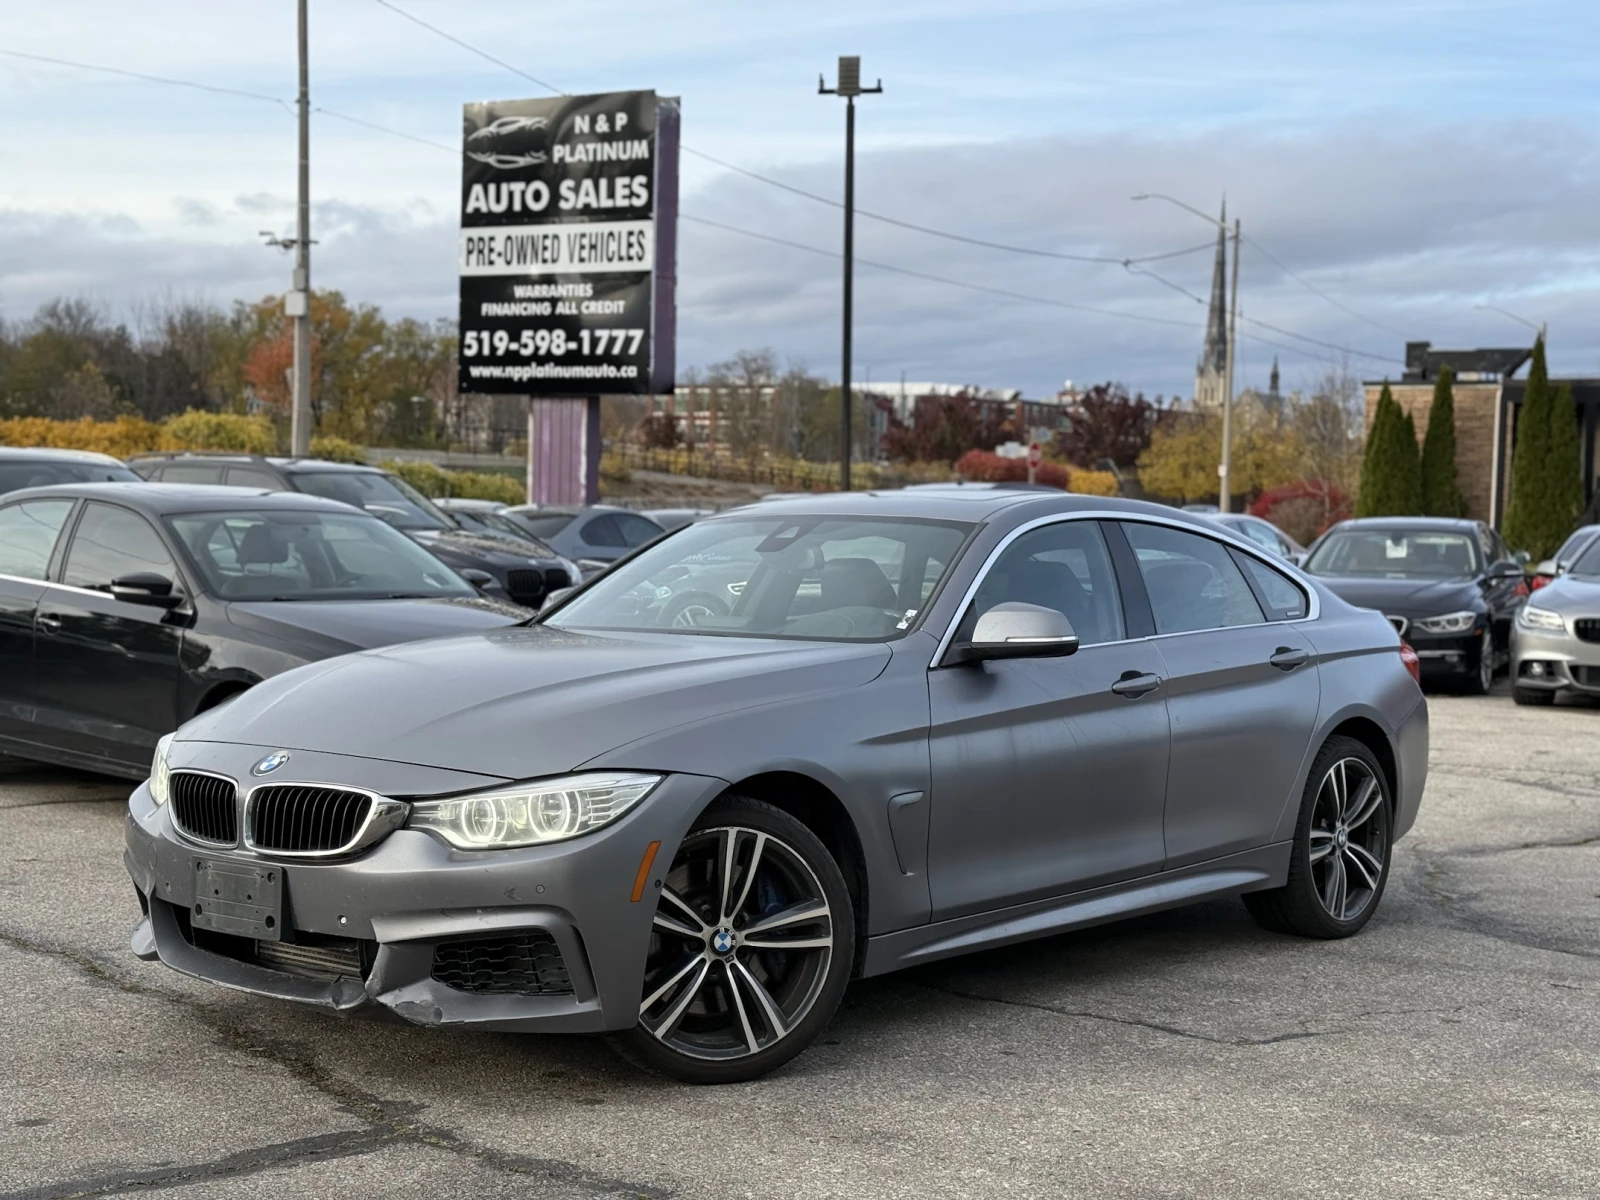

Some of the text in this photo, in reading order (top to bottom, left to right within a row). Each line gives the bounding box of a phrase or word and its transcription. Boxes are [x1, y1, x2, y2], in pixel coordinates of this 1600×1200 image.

[574, 111, 628, 134] N & P
[552, 139, 649, 164] PLATINUM
[465, 175, 649, 213] AUTO SALES
[466, 230, 646, 267] PRE-OWNED VEHICLES
[513, 283, 594, 299] WARRANTIES
[481, 300, 626, 317] FINANCING ALL CREDIT
[463, 328, 645, 357] 519-598-1777
[469, 361, 638, 383] www.npplatinumauto.ca
